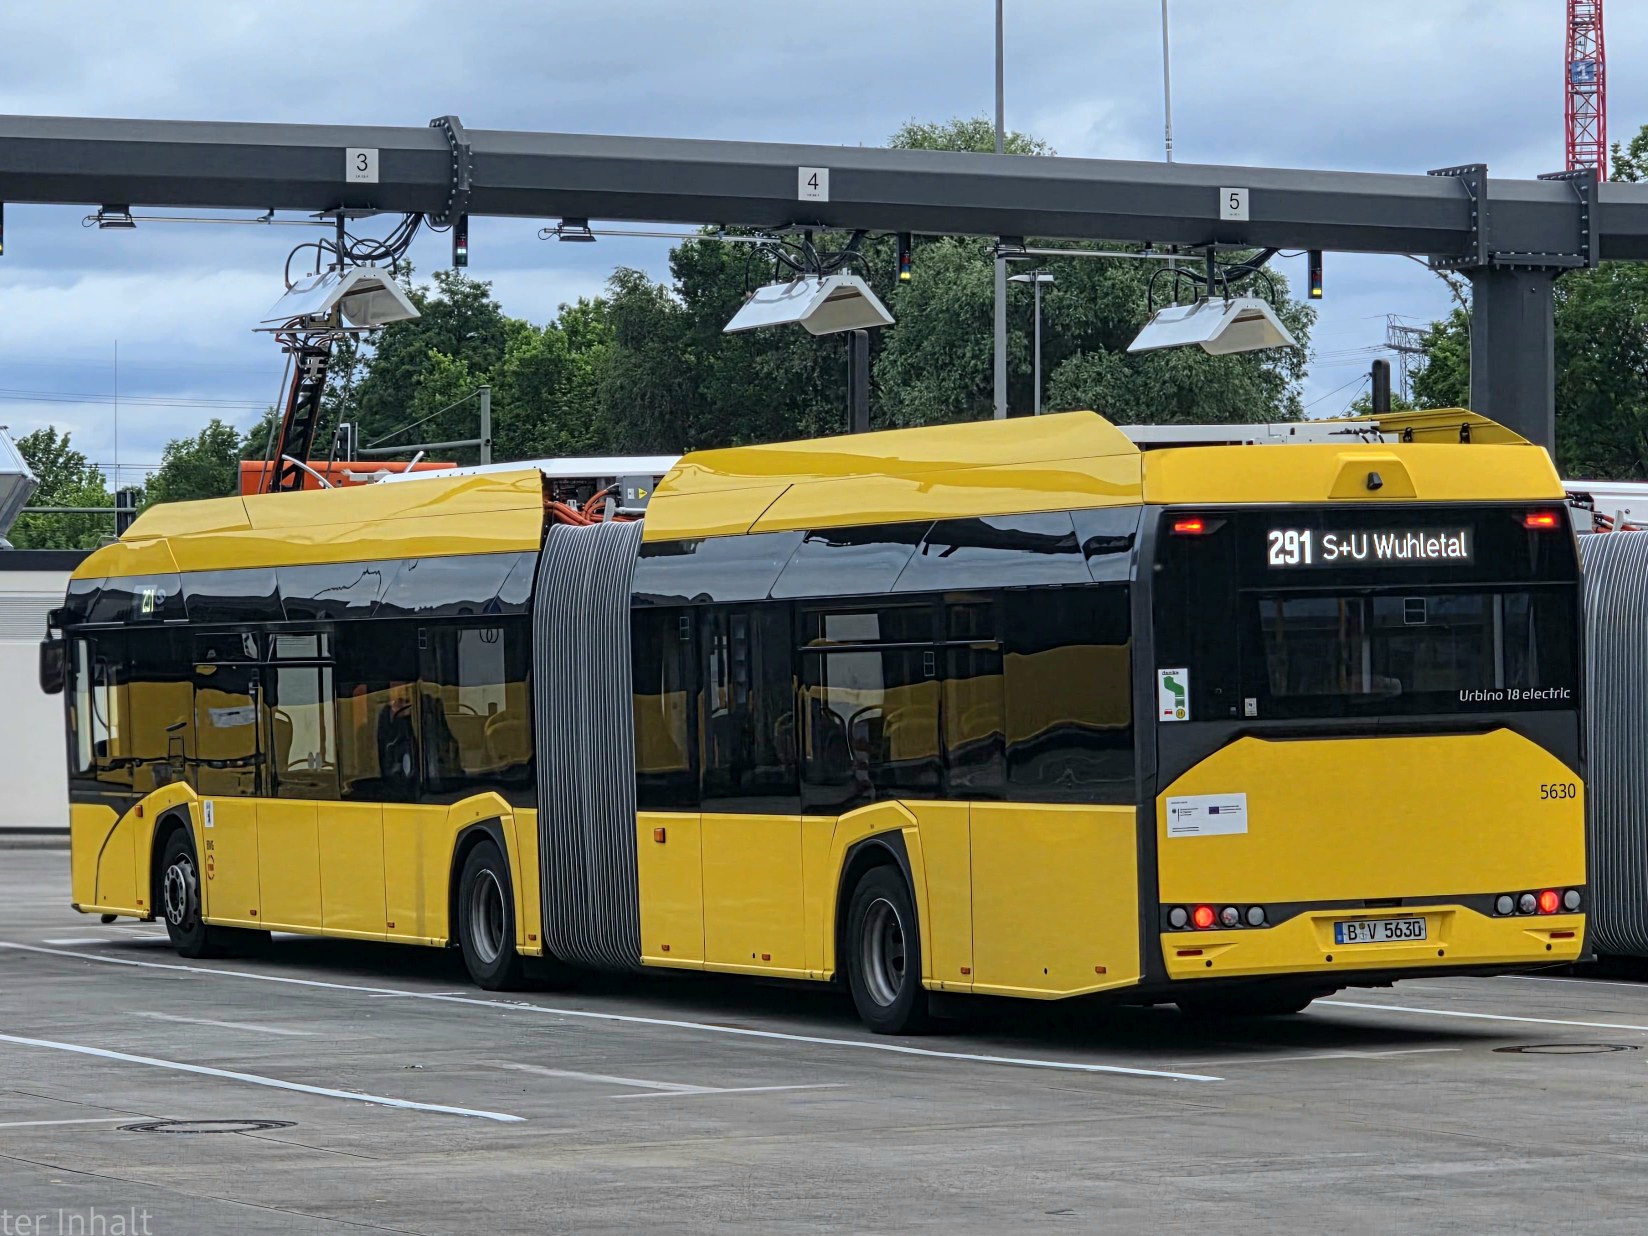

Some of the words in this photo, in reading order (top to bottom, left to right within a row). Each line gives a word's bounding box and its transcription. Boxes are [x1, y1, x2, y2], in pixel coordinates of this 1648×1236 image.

[356, 153, 368, 172] 3
[807, 172, 819, 191] 4
[1229, 192, 1240, 210] 5
[1268, 530, 1313, 565] 291
[1322, 533, 1368, 560] S+U
[1373, 531, 1468, 559] Wuhletal
[1459, 689, 1504, 702] Urbino
[1506, 688, 1520, 701] 18
[1522, 687, 1571, 700] electric
[1540, 783, 1576, 800] 5630
[1347, 924, 1358, 941] B
[1367, 923, 1377, 940] V
[1384, 921, 1422, 939] 5630
